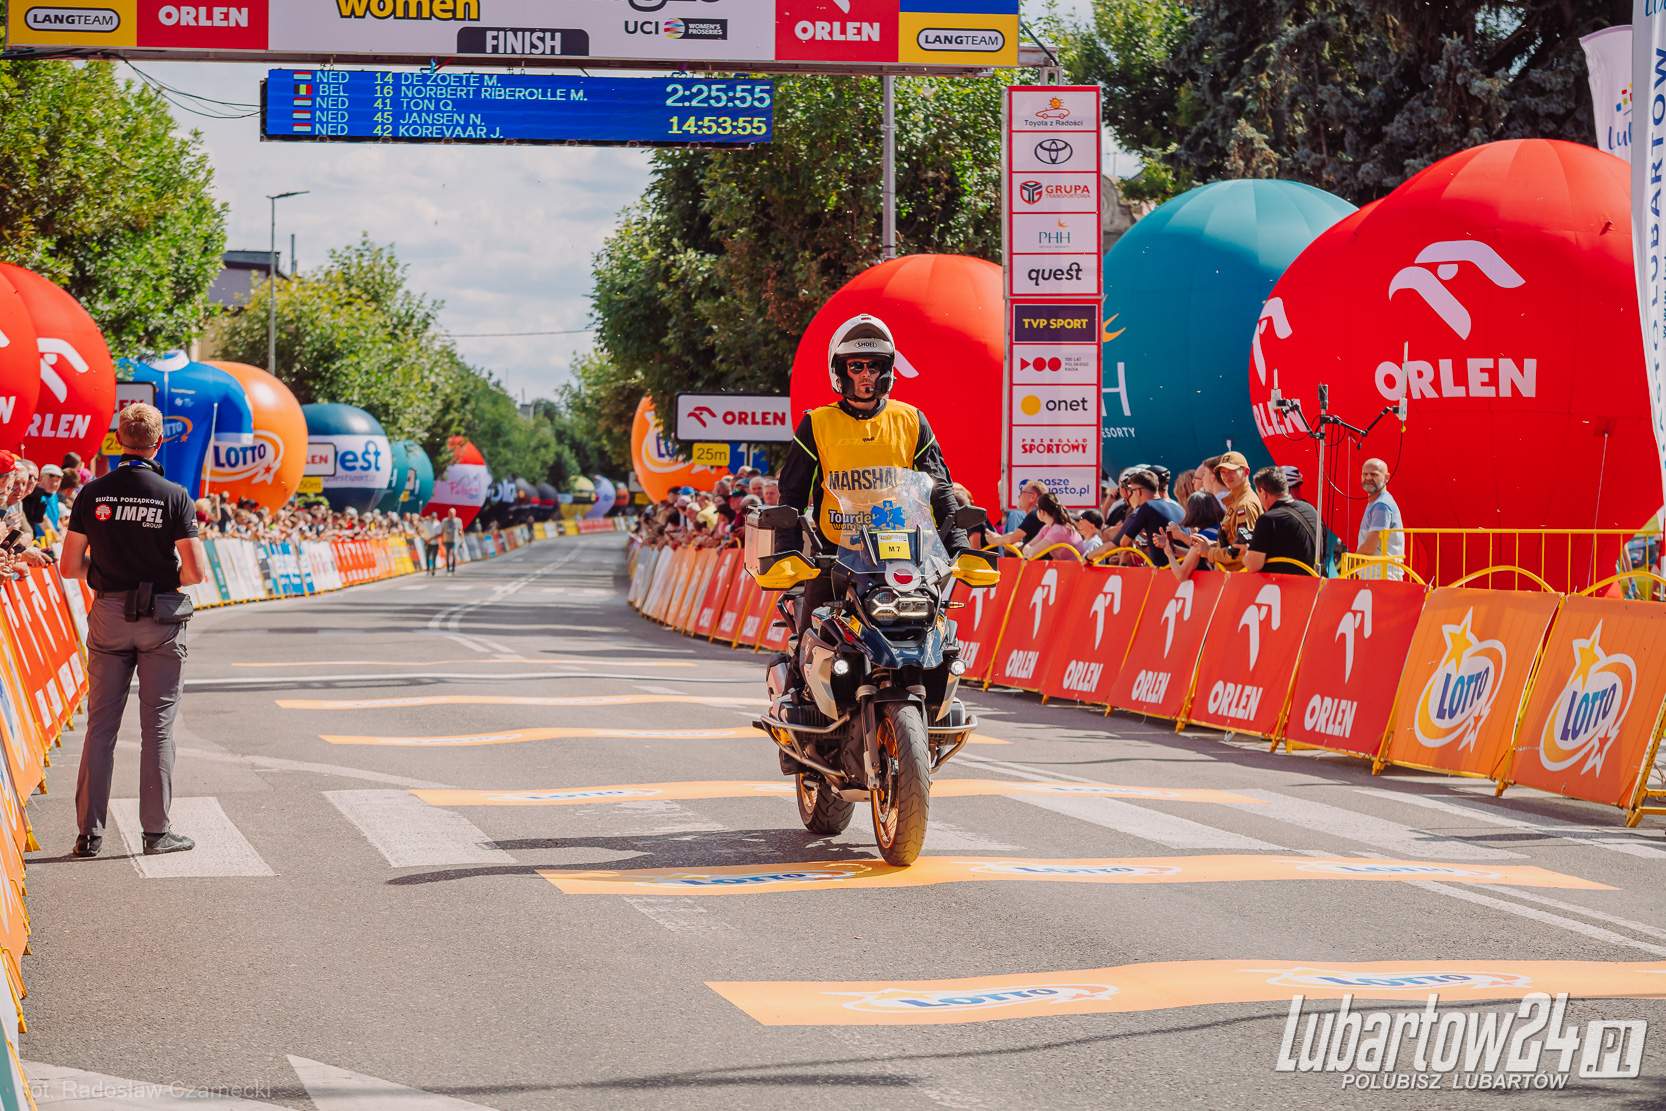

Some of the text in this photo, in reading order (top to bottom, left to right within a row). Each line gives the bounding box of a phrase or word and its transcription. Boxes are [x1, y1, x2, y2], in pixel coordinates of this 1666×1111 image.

[32, 13, 114, 26] LANGTEAM
[157, 5, 249, 27] ORLEN
[623, 20, 660, 35] UCI
[688, 23, 721, 31] WOMEN'S
[688, 28, 723, 36] PROSERIES
[794, 20, 881, 42] ORLEN
[485, 29, 561, 55] FINISH
[924, 34, 999, 46] LANGTEAM
[316, 71, 501, 87] NED 14 DE ZOETE M.
[319, 84, 588, 101] BEL 16 NORBERT RIBEROLLE M.
[665, 84, 771, 108] 2:25:55
[316, 97, 457, 112] NED 41 TON Q.
[315, 110, 485, 125] NED 45 JANSEN N.
[668, 115, 767, 135] 14:53:55
[1024, 120, 1048, 128] Toyota
[315, 123, 504, 139] NED 42 KOREVAAR J.
[1045, 185, 1091, 194] GRUPA
[1038, 231, 1071, 244] PHH
[1027, 262, 1083, 287] quest
[1022, 318, 1089, 329] TVP SPORT
[1374, 357, 1538, 401] ORLEN
[1045, 397, 1089, 411] onet
[722, 410, 786, 426] ORLEN
[213, 443, 267, 468] LOTTO
[696, 447, 727, 461] 25m
[1022, 443, 1088, 454] SPORTOWY
[120, 496, 165, 507] PORZĄDKOWA
[115, 505, 164, 524] IMPEL
[142, 521, 164, 529] GROUP
[1005, 649, 1040, 679] ORLEN
[1062, 660, 1104, 693] ORLEN
[1130, 669, 1172, 705] ORLEN
[1435, 662, 1490, 721] LOTTO
[1207, 680, 1264, 721] ORLEN
[1303, 693, 1358, 739] ORLEN
[1560, 677, 1619, 742] LOTTO
[900, 987, 1059, 1008] LOTTO
